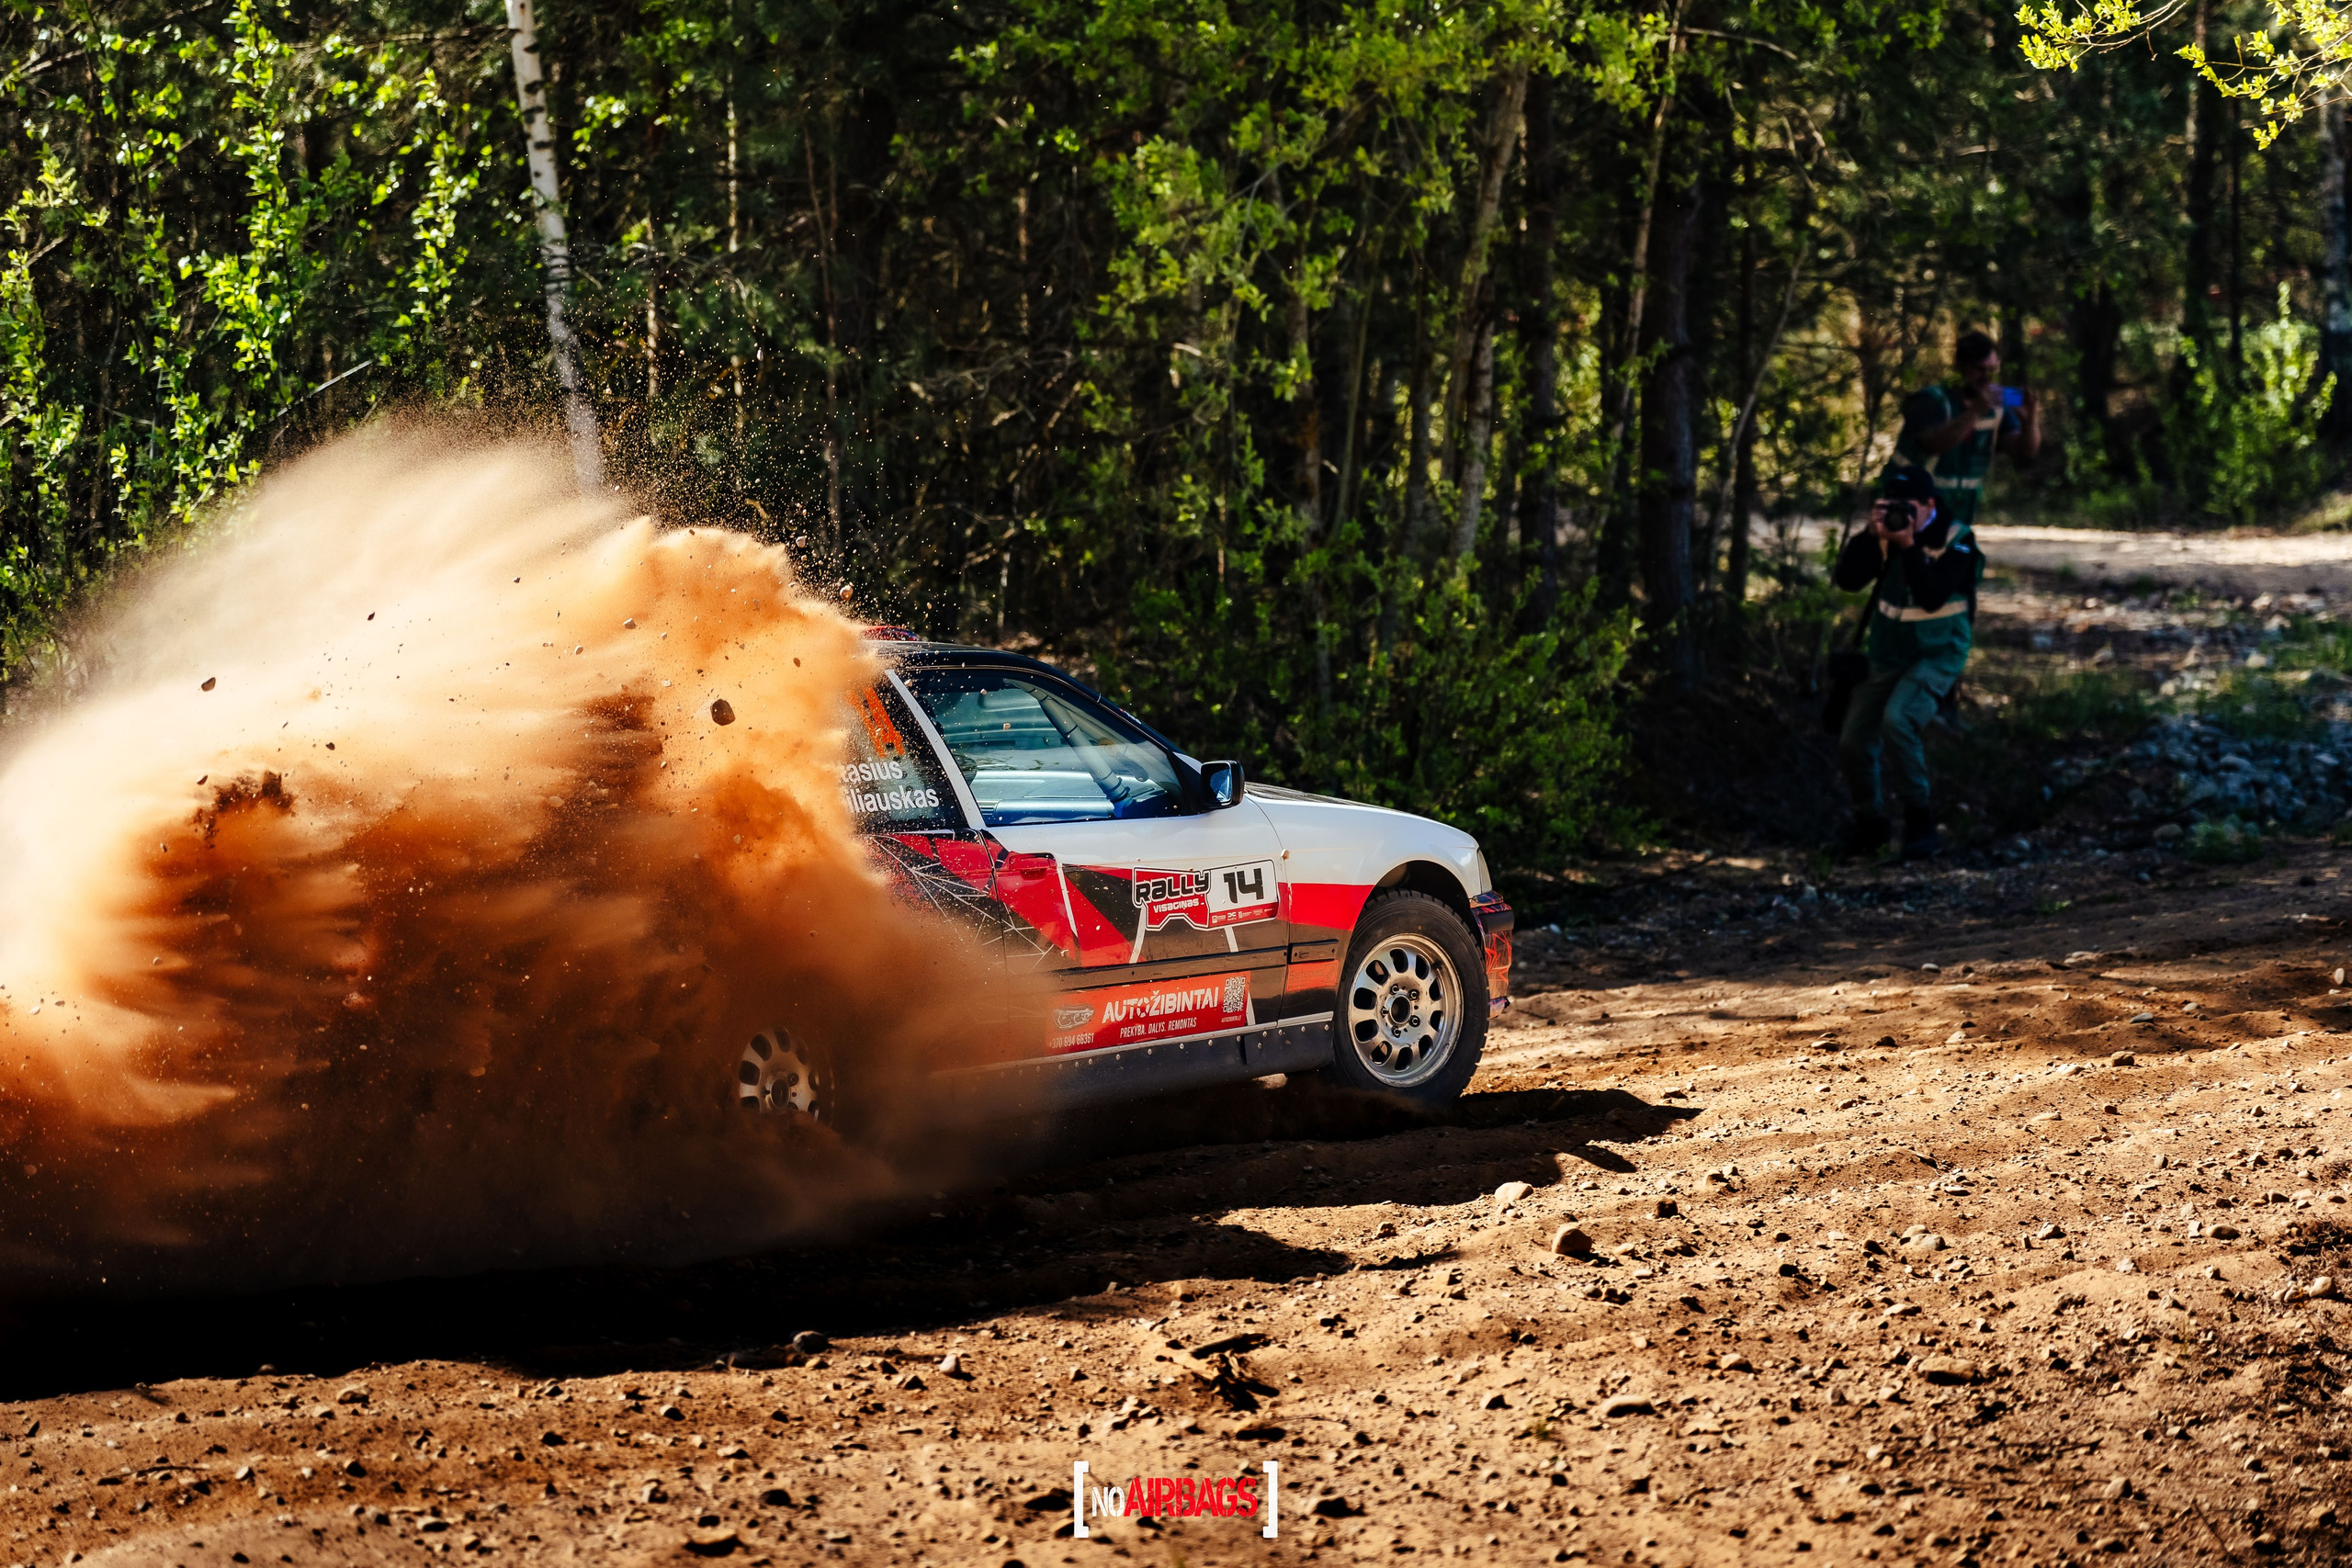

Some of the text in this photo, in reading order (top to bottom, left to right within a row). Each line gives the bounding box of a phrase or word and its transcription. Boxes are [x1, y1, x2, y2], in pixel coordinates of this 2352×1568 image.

[1134, 872, 1210, 904] RALLY
[1223, 867, 1264, 904] 14
[1102, 986, 1219, 1024] AUTOŽIBINTAI
[1064, 1034, 1076, 1047] 694
[1119, 1017, 1197, 1039] PREKYBA. DALYS. REMONTAS
